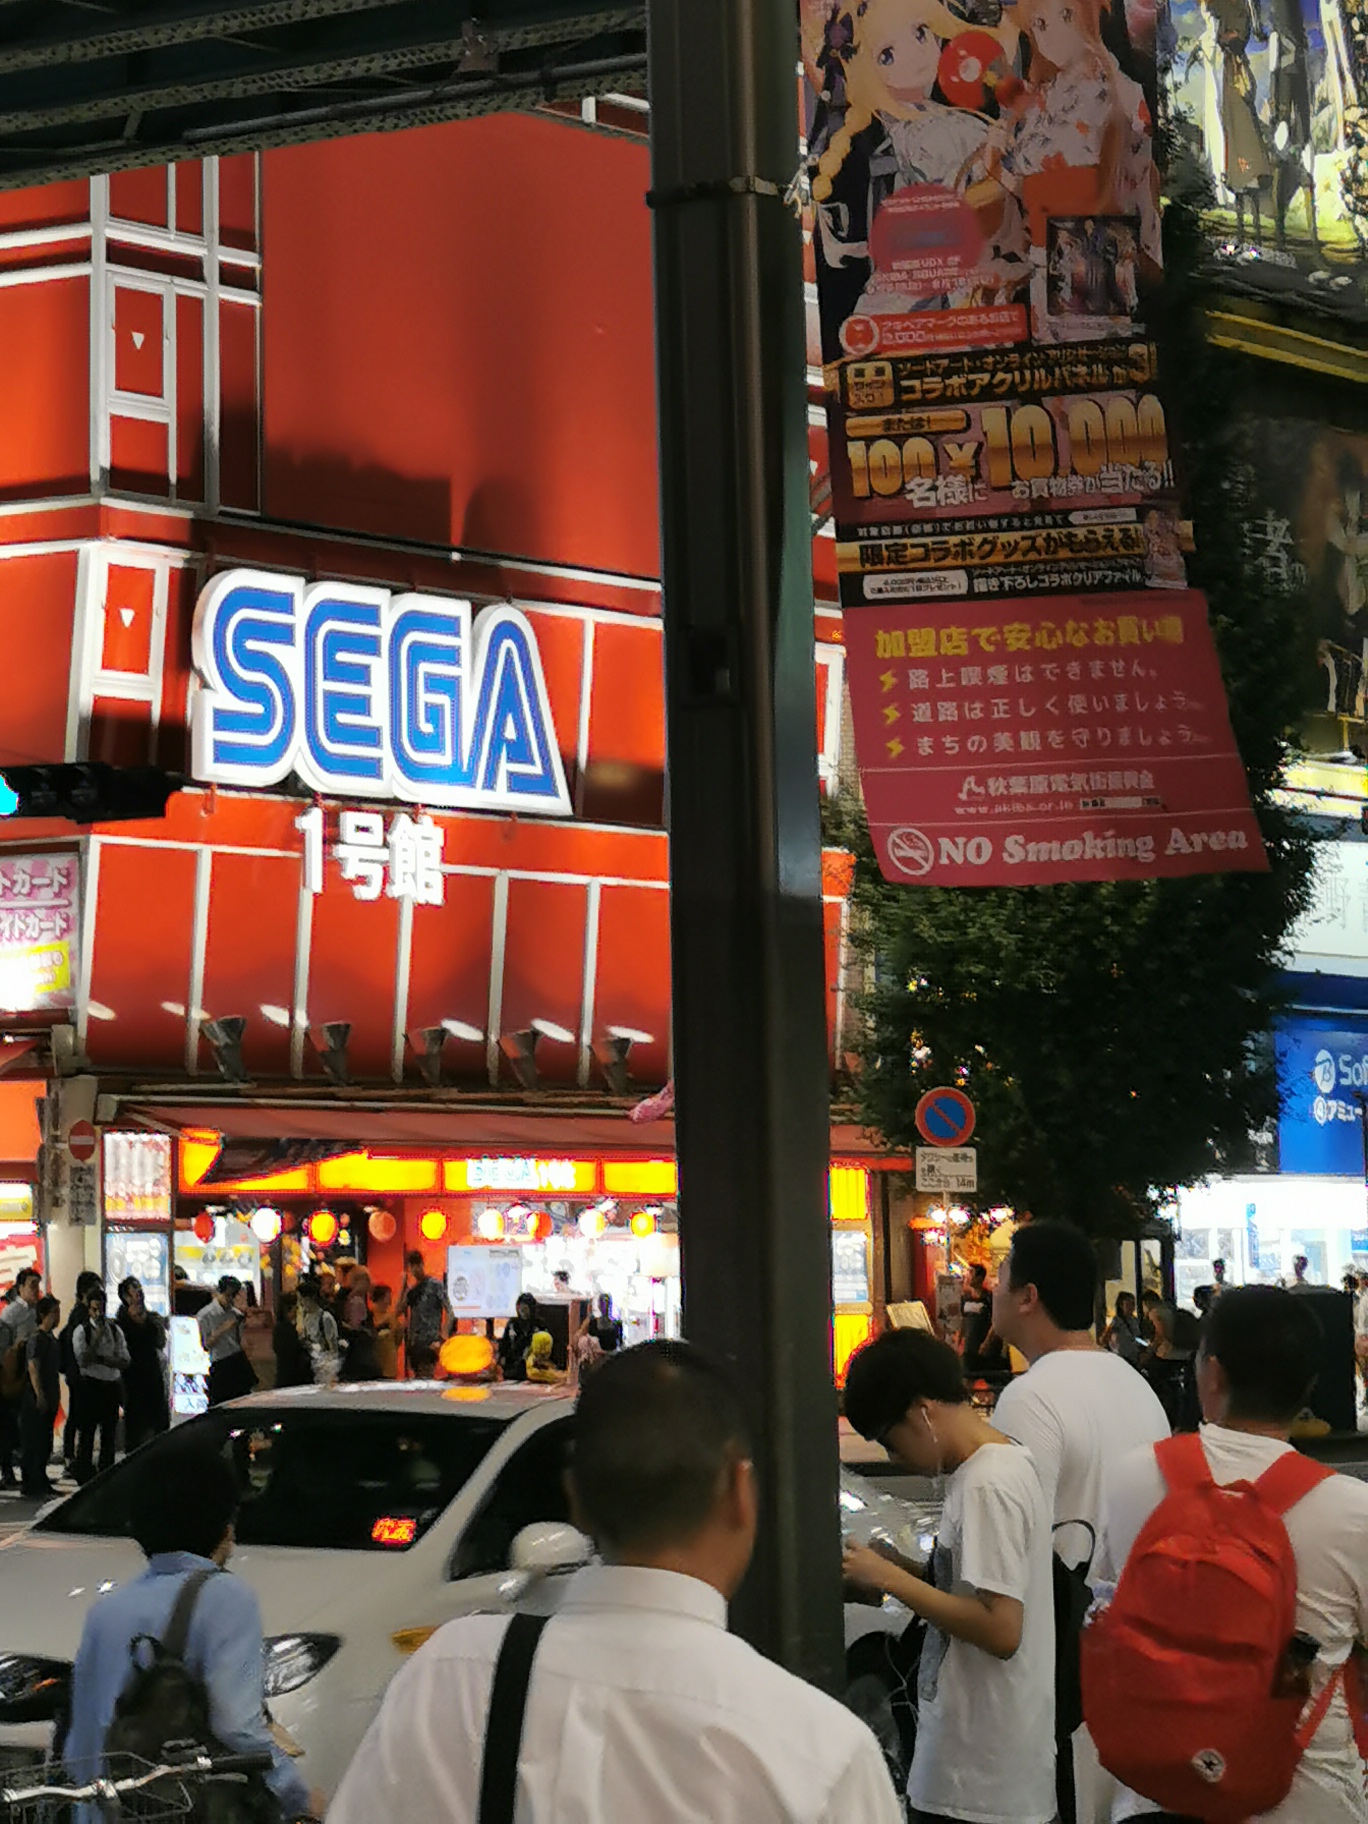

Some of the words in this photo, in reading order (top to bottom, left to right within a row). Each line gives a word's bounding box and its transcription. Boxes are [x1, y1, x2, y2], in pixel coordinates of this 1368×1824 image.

[192, 568, 574, 815] SEGA
[296, 808, 446, 906] 1号館
[938, 835, 993, 866] NO
[1002, 828, 1156, 866] Smoking
[1164, 826, 1249, 857] Area
